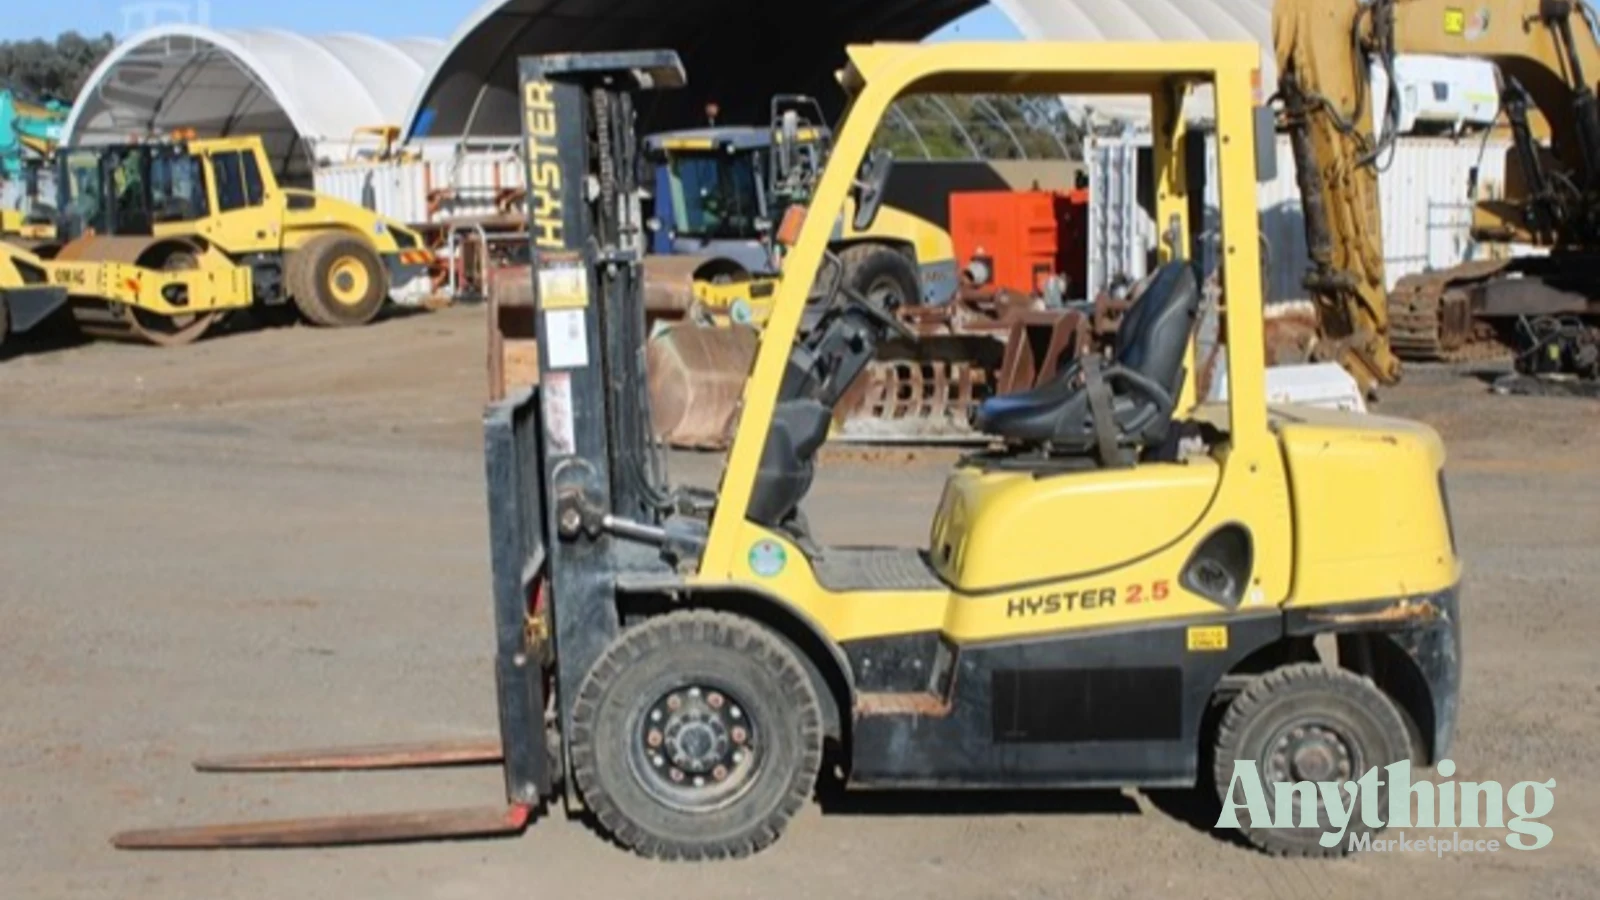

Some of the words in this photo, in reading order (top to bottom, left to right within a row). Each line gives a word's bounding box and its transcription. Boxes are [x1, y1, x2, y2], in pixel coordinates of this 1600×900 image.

[525, 80, 565, 249] HYSTER
[1006, 587, 1117, 618] HYSTER
[1124, 579, 1169, 604] 2.5
